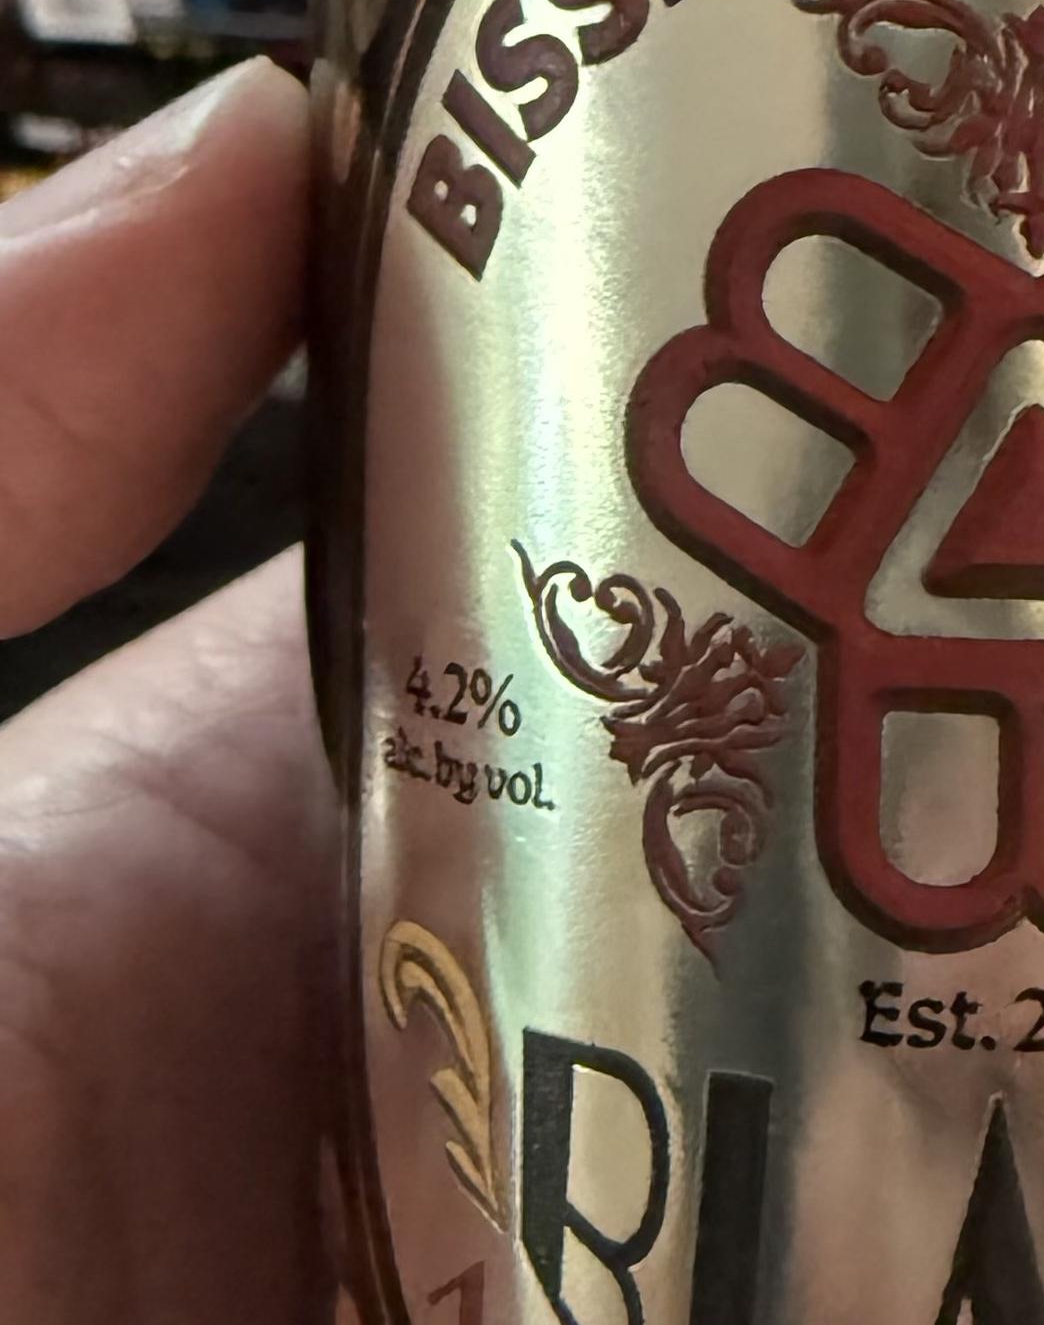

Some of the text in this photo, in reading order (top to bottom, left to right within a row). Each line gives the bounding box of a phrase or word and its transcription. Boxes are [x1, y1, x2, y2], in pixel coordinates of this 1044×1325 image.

[405, 655, 522, 737] 4.2%
[434, 741, 479, 805] by
[858, 979, 996, 1051] Est.
